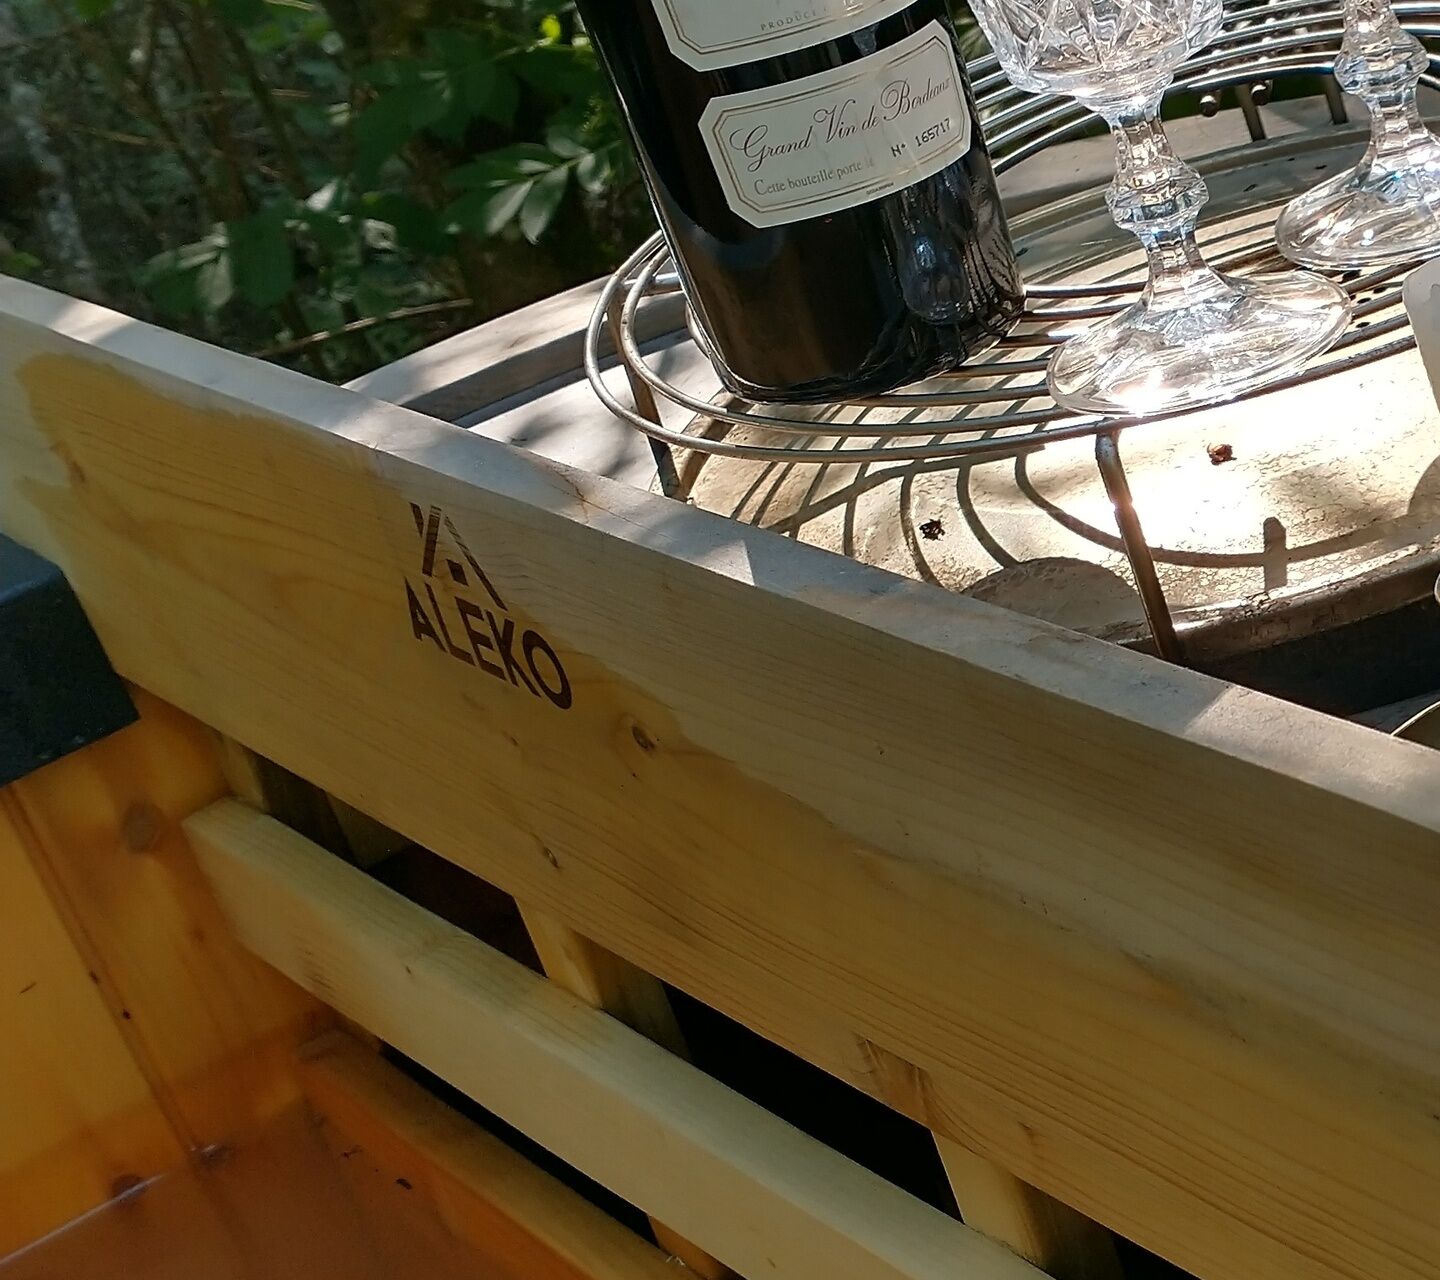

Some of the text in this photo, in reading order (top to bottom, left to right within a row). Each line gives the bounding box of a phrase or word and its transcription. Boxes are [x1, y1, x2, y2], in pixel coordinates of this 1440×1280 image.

[729, 124, 813, 172] Grand
[813, 98, 857, 143] Vin
[861, 105, 879, 131] de
[914, 117, 951, 148] 165717
[753, 178, 786, 196] Cette
[787, 168, 834, 190] bouteille
[836, 162, 863, 180] porte
[404, 576, 572, 710] ALEKO
